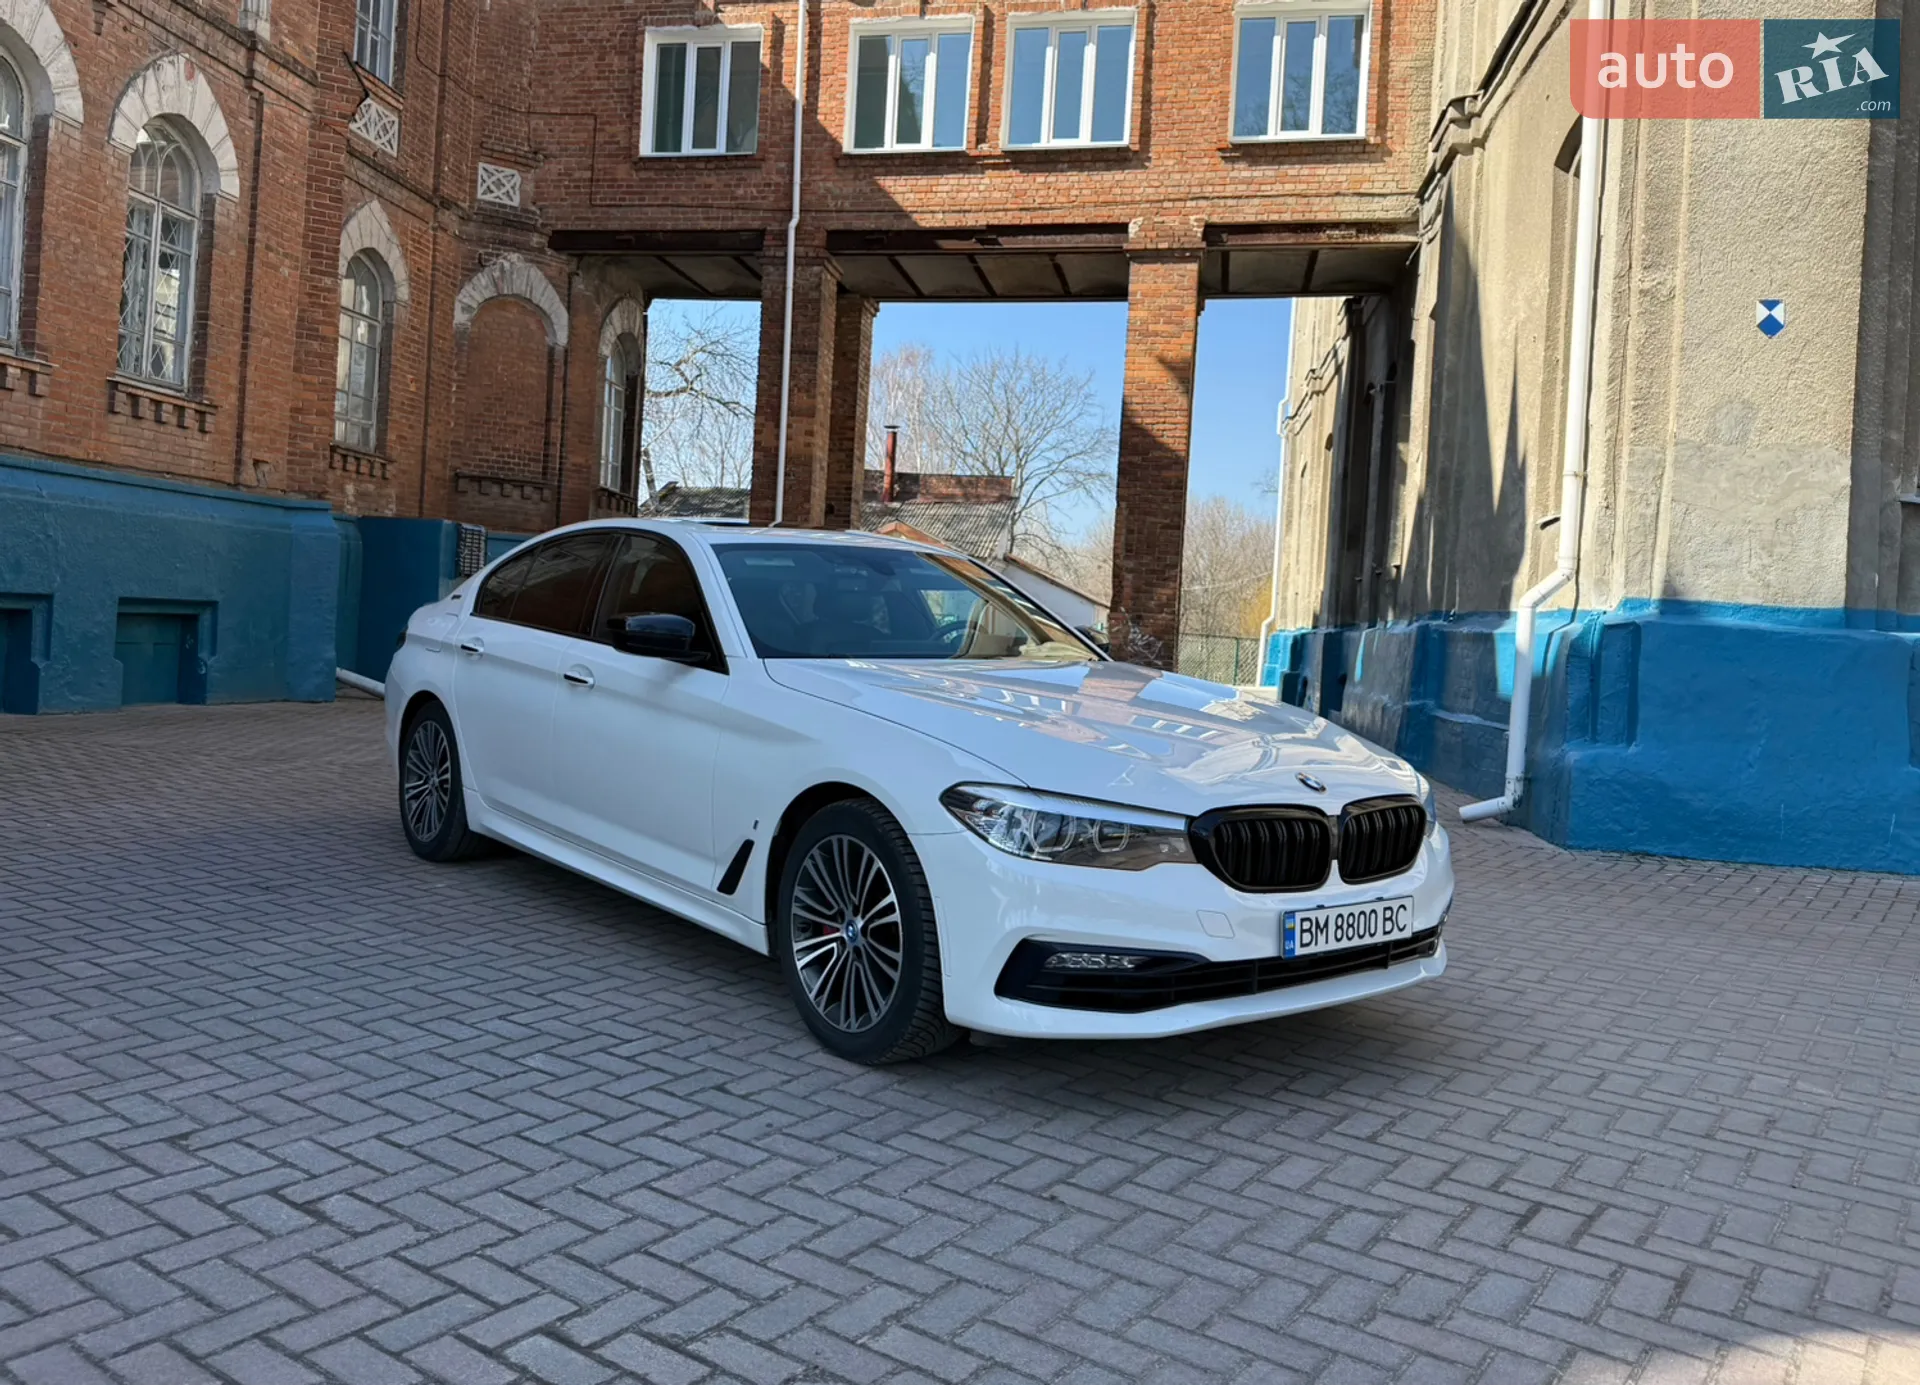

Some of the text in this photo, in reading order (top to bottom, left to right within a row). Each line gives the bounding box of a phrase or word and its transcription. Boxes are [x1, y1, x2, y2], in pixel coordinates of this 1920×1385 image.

[1300, 904, 1407, 948] BM 8800 BC
